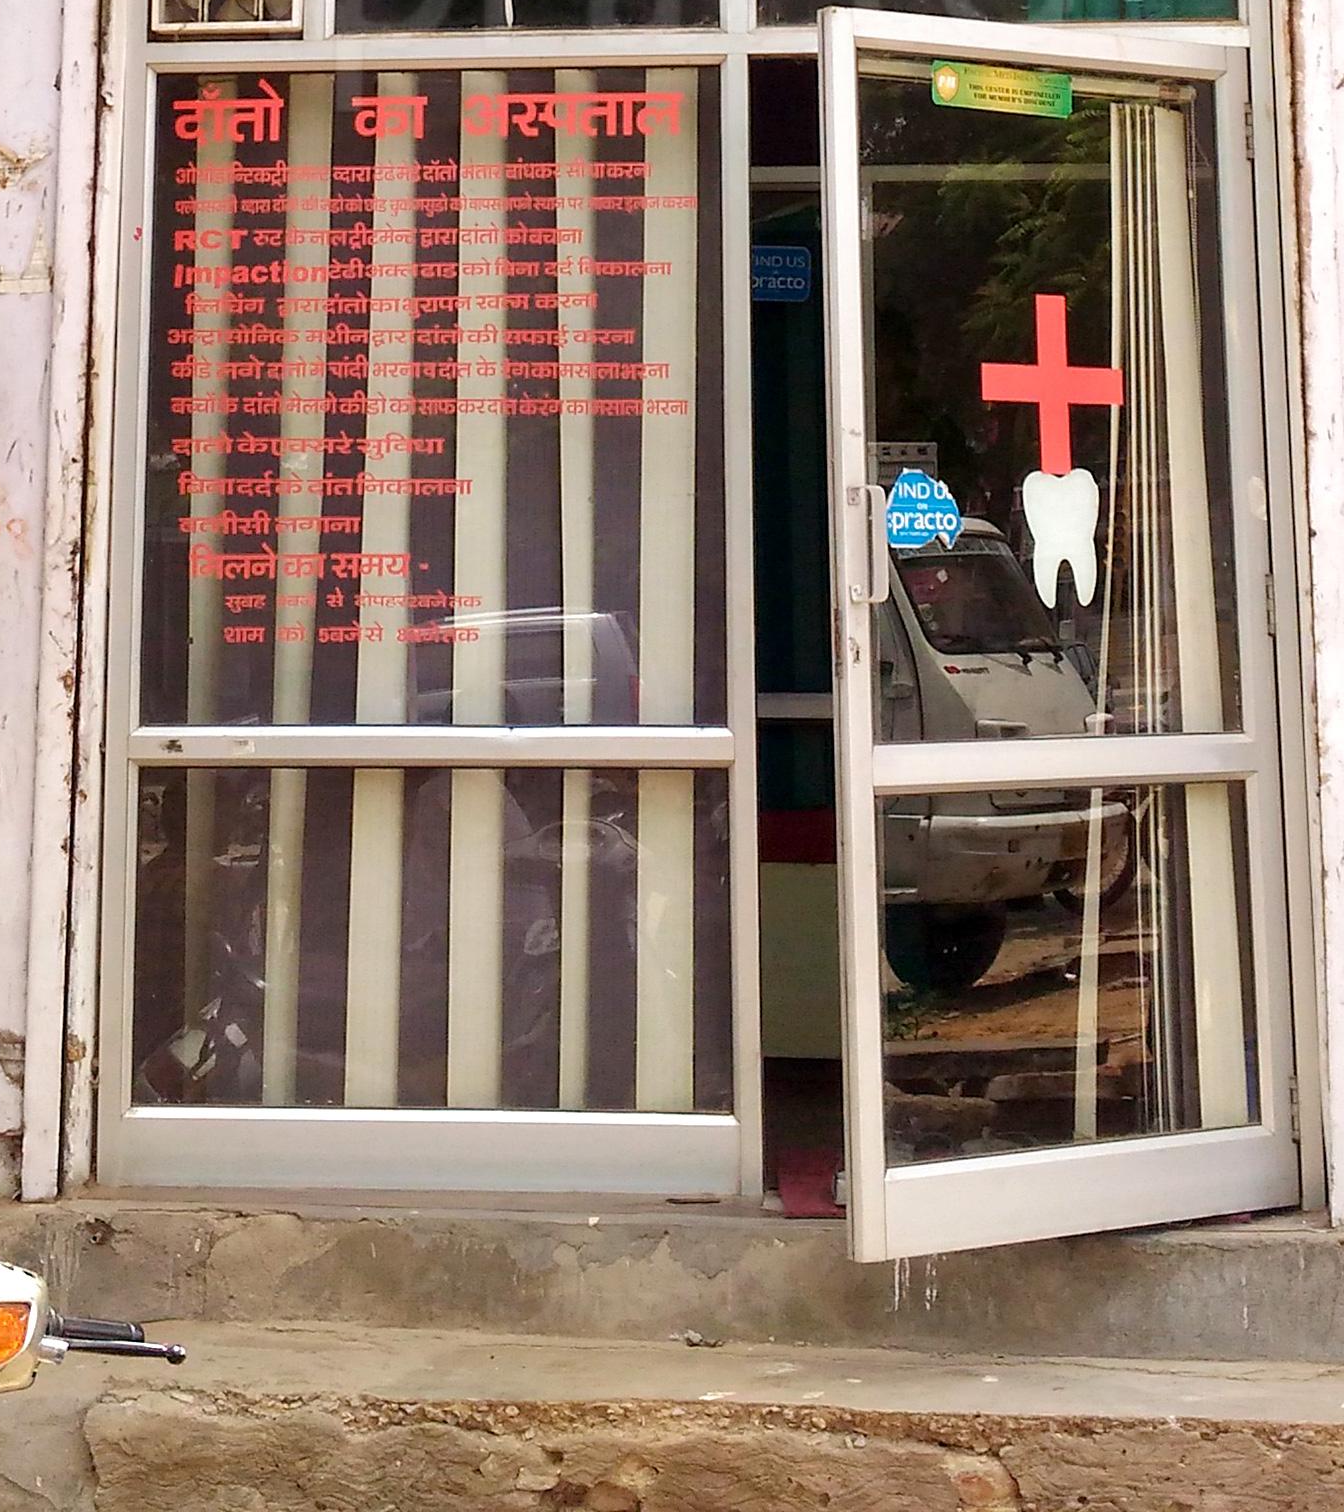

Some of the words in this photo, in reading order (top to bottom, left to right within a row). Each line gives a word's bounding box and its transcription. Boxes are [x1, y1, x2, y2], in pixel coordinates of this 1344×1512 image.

[352, 96, 428, 139] का
[463, 91, 684, 139] अस्पताल
[173, 229, 248, 251] RCT
[891, 510, 957, 536] practo
[283, 552, 325, 579] का
[330, 553, 412, 580] समय
[223, 626, 265, 643] शाम
